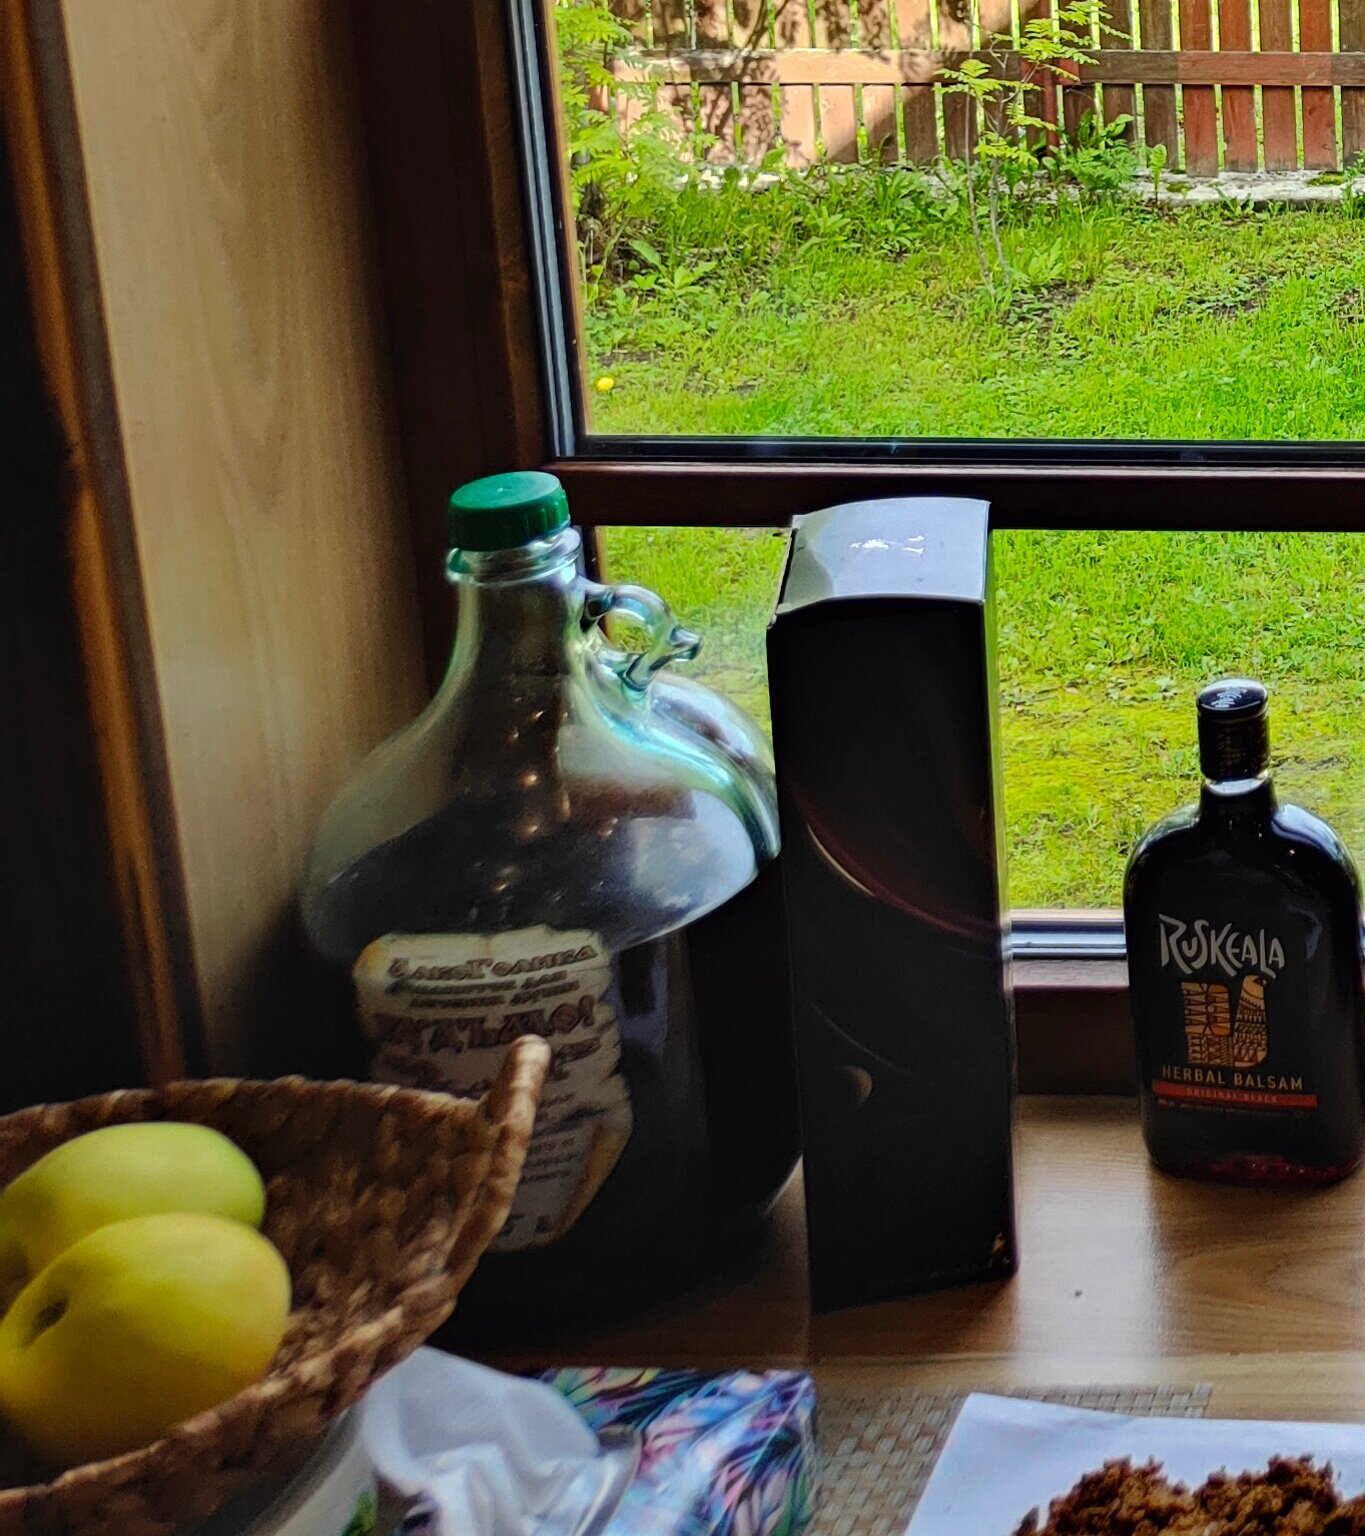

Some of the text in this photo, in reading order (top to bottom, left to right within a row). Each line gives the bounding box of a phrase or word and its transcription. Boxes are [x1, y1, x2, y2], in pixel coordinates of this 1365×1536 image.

[1158, 913, 1285, 979] RUSKEALA
[1162, 1064, 1303, 1091] HERBAL BALSAM
[1186, 1087, 1240, 1101] ORIGINAL
